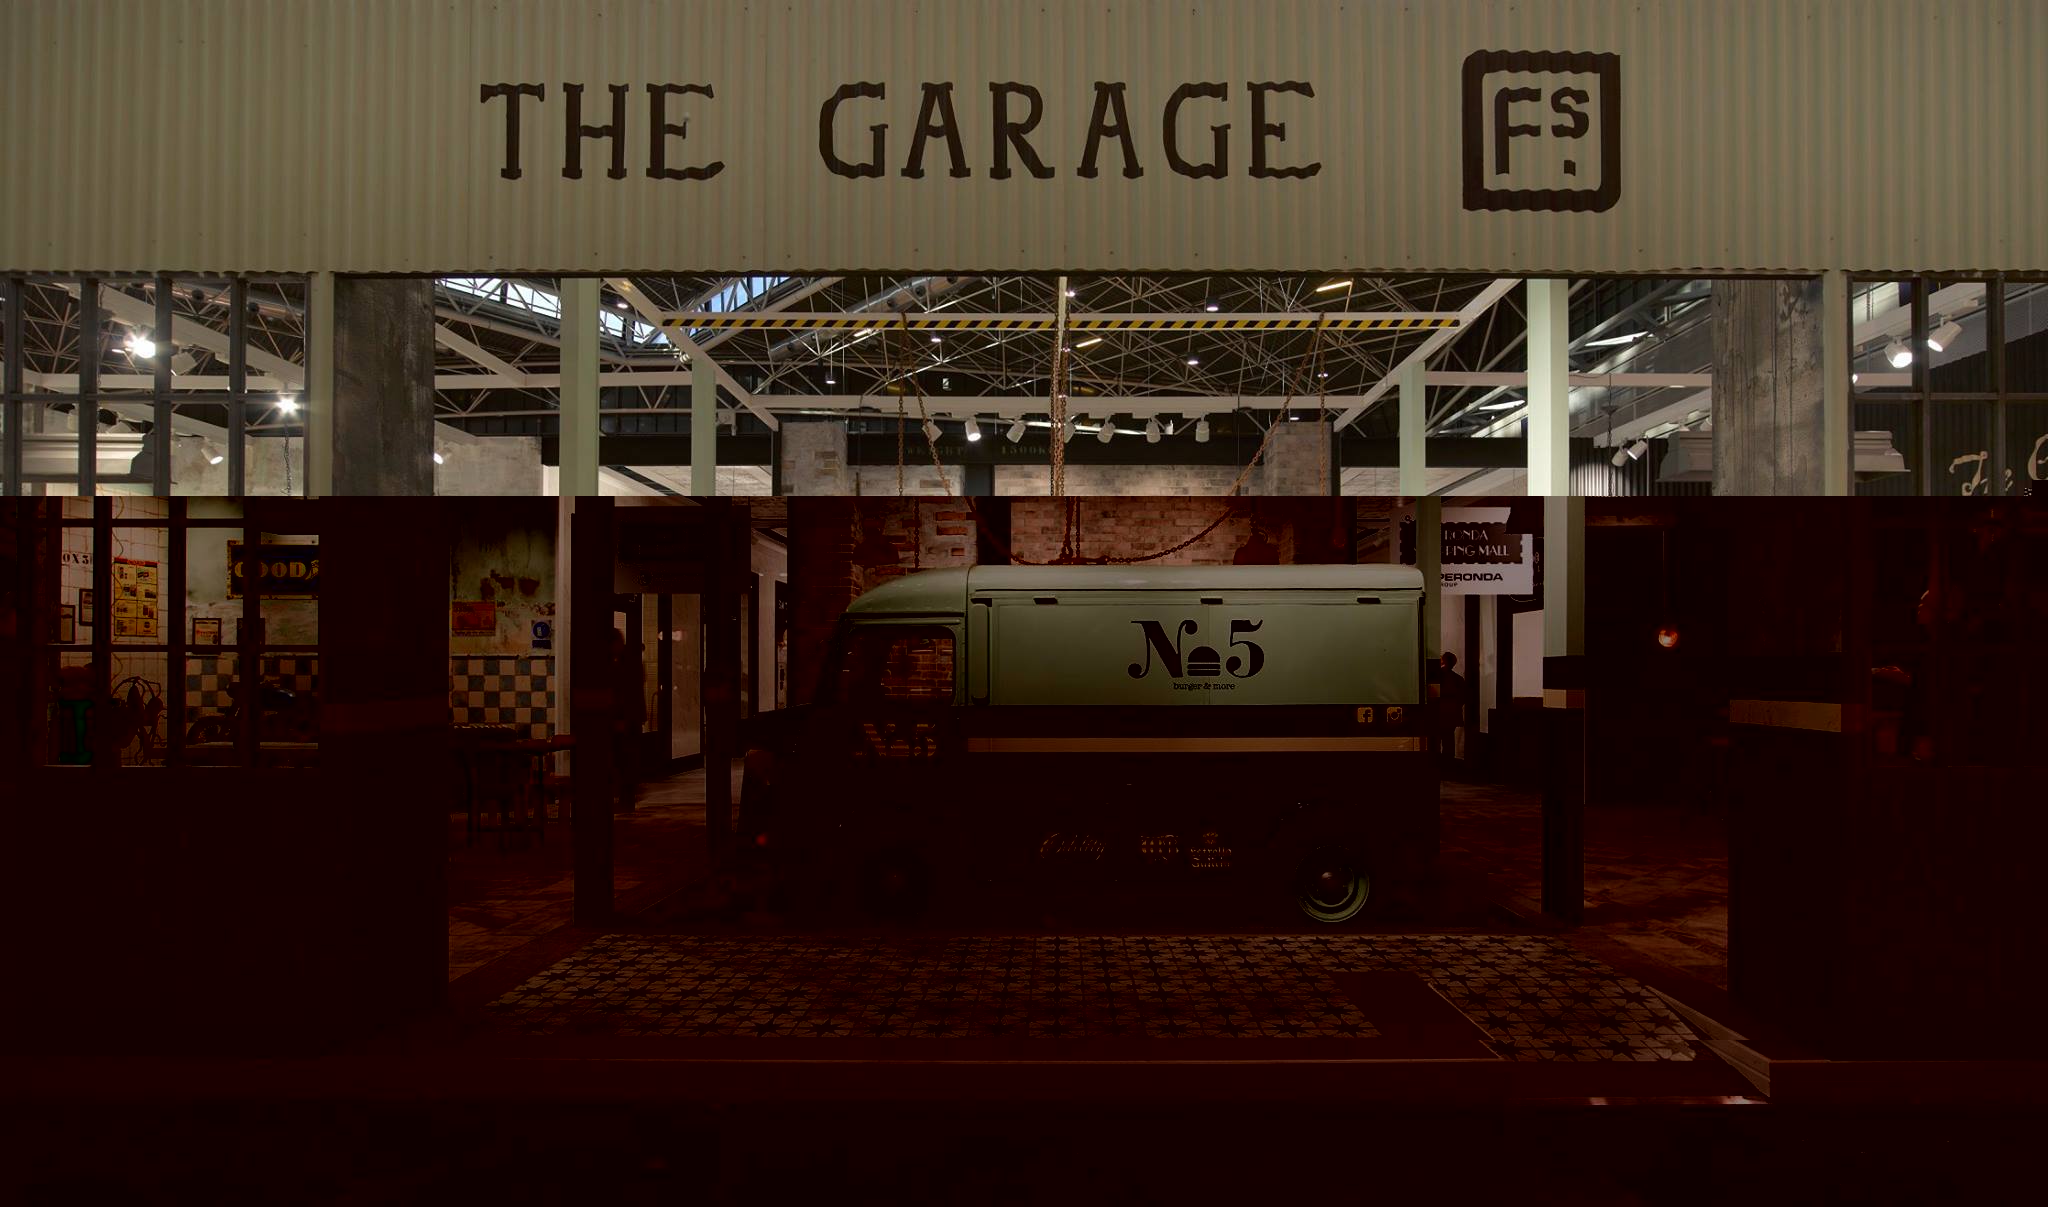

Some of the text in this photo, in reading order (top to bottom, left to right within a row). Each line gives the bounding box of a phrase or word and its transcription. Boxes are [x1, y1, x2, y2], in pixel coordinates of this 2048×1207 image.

[481, 81, 1321, 180] THE GARAGE
[904, 445, 964, 456] WEGHT
[1444, 529, 1489, 541] RONDA
[1478, 544, 1509, 557] MALL
[1173, 682, 1202, 691] burger
